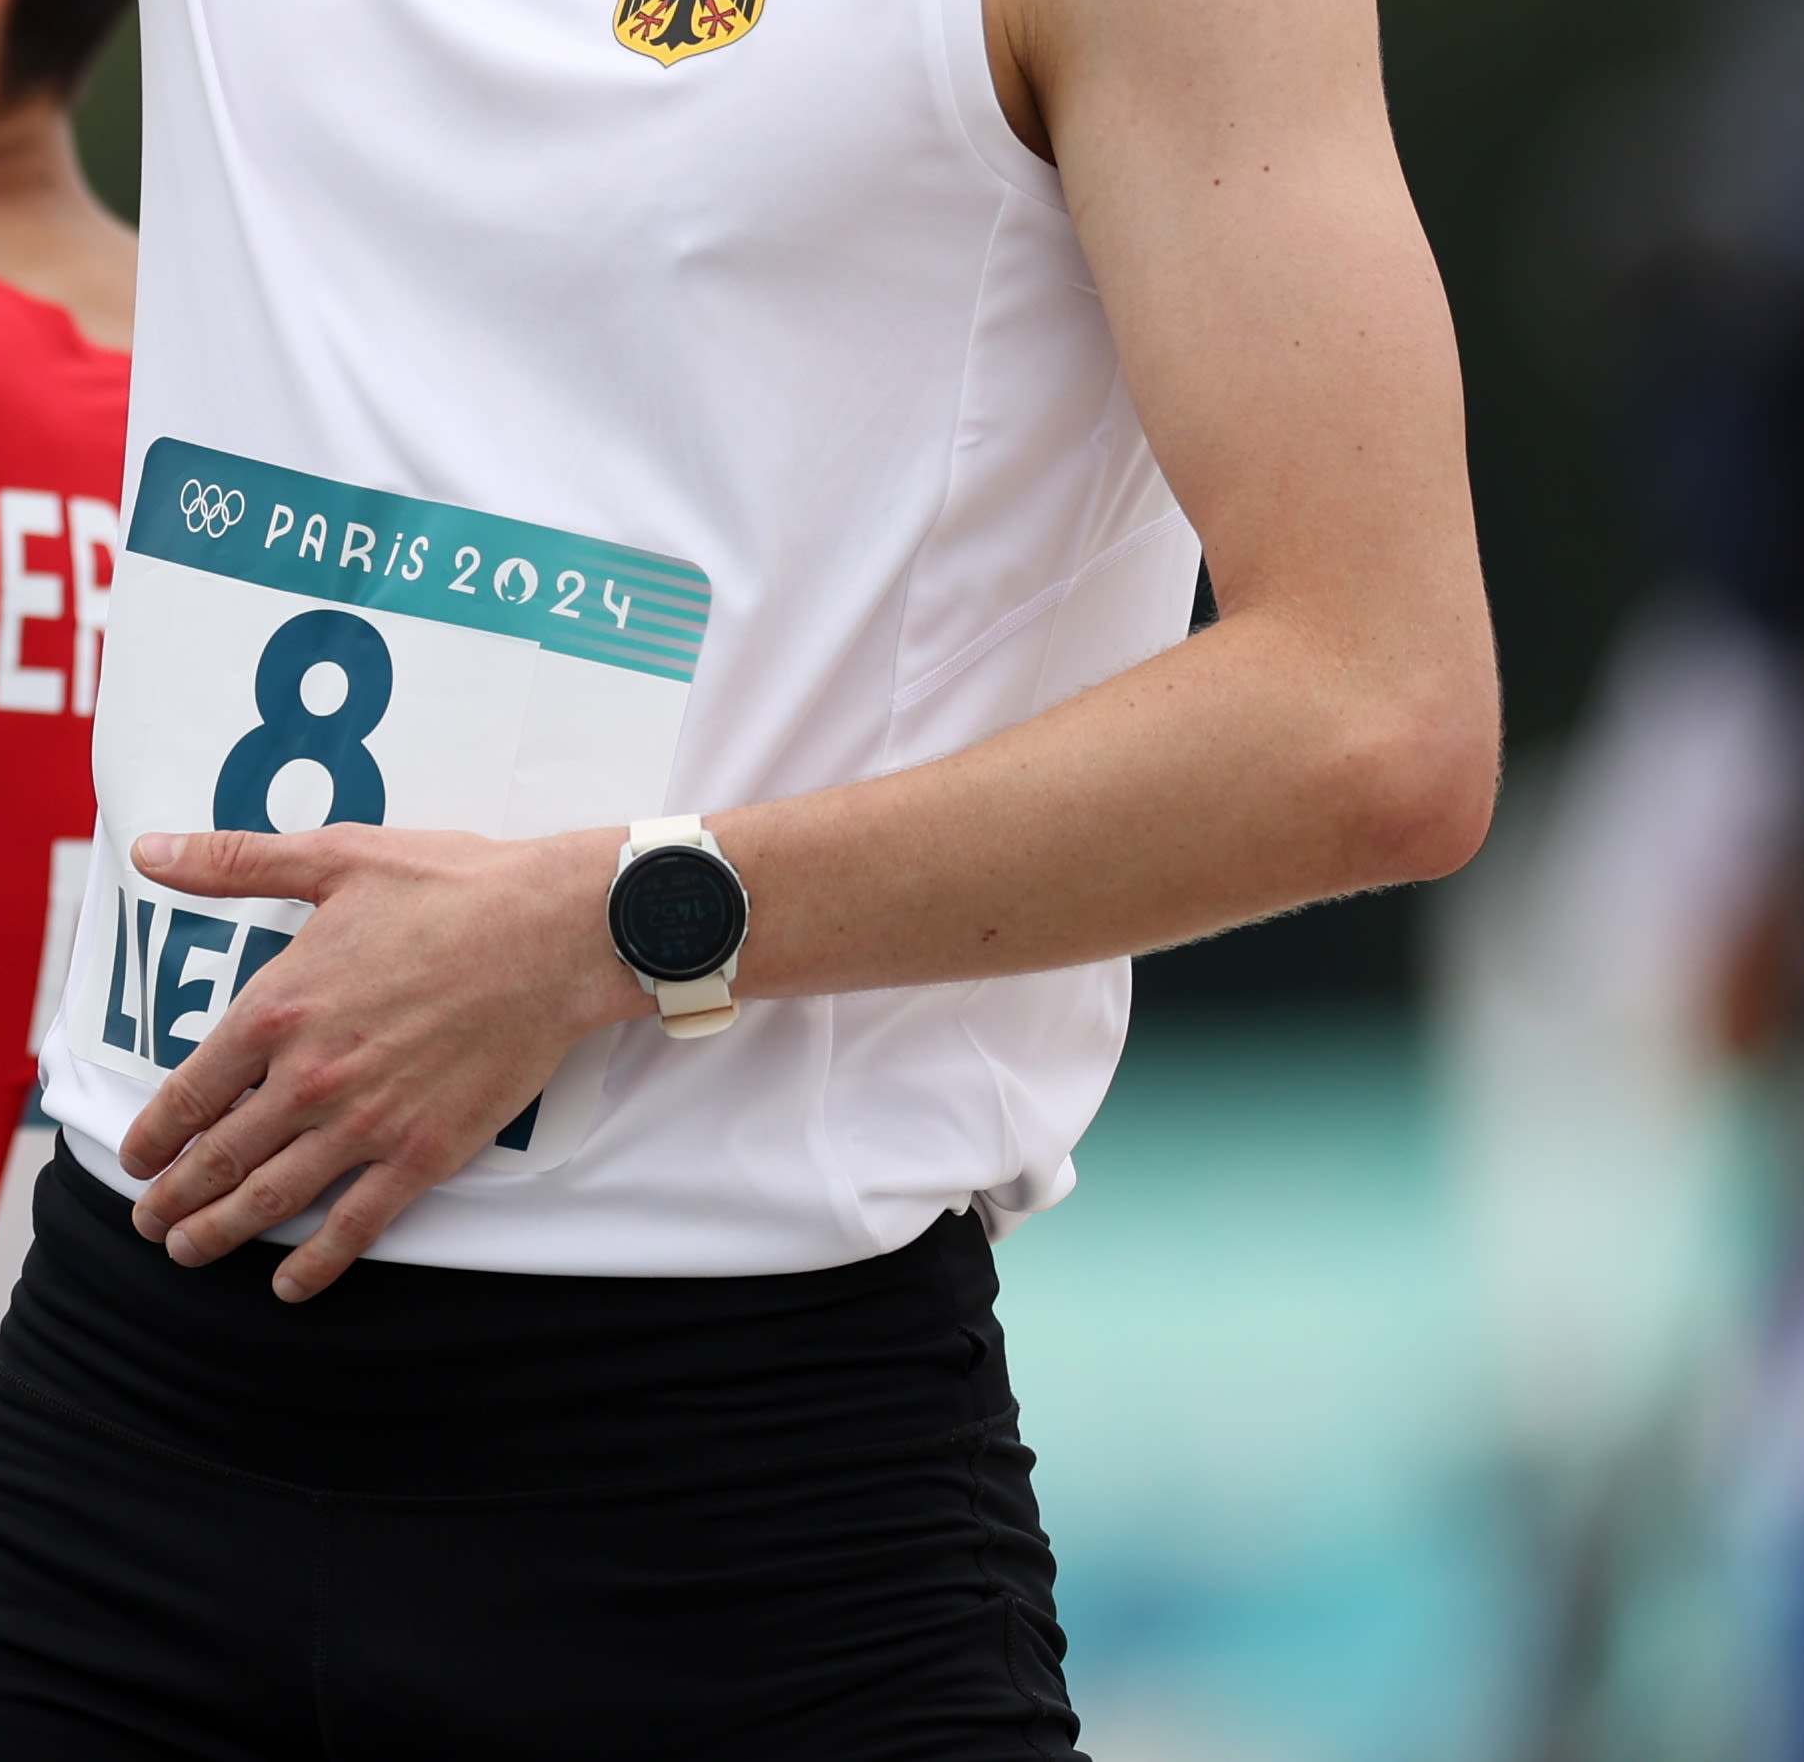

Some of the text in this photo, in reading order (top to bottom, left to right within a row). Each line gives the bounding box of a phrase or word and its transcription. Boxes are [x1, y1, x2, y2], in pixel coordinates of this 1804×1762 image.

[264, 503, 633, 630] PARIS 2024
[212, 608, 394, 835] 8
